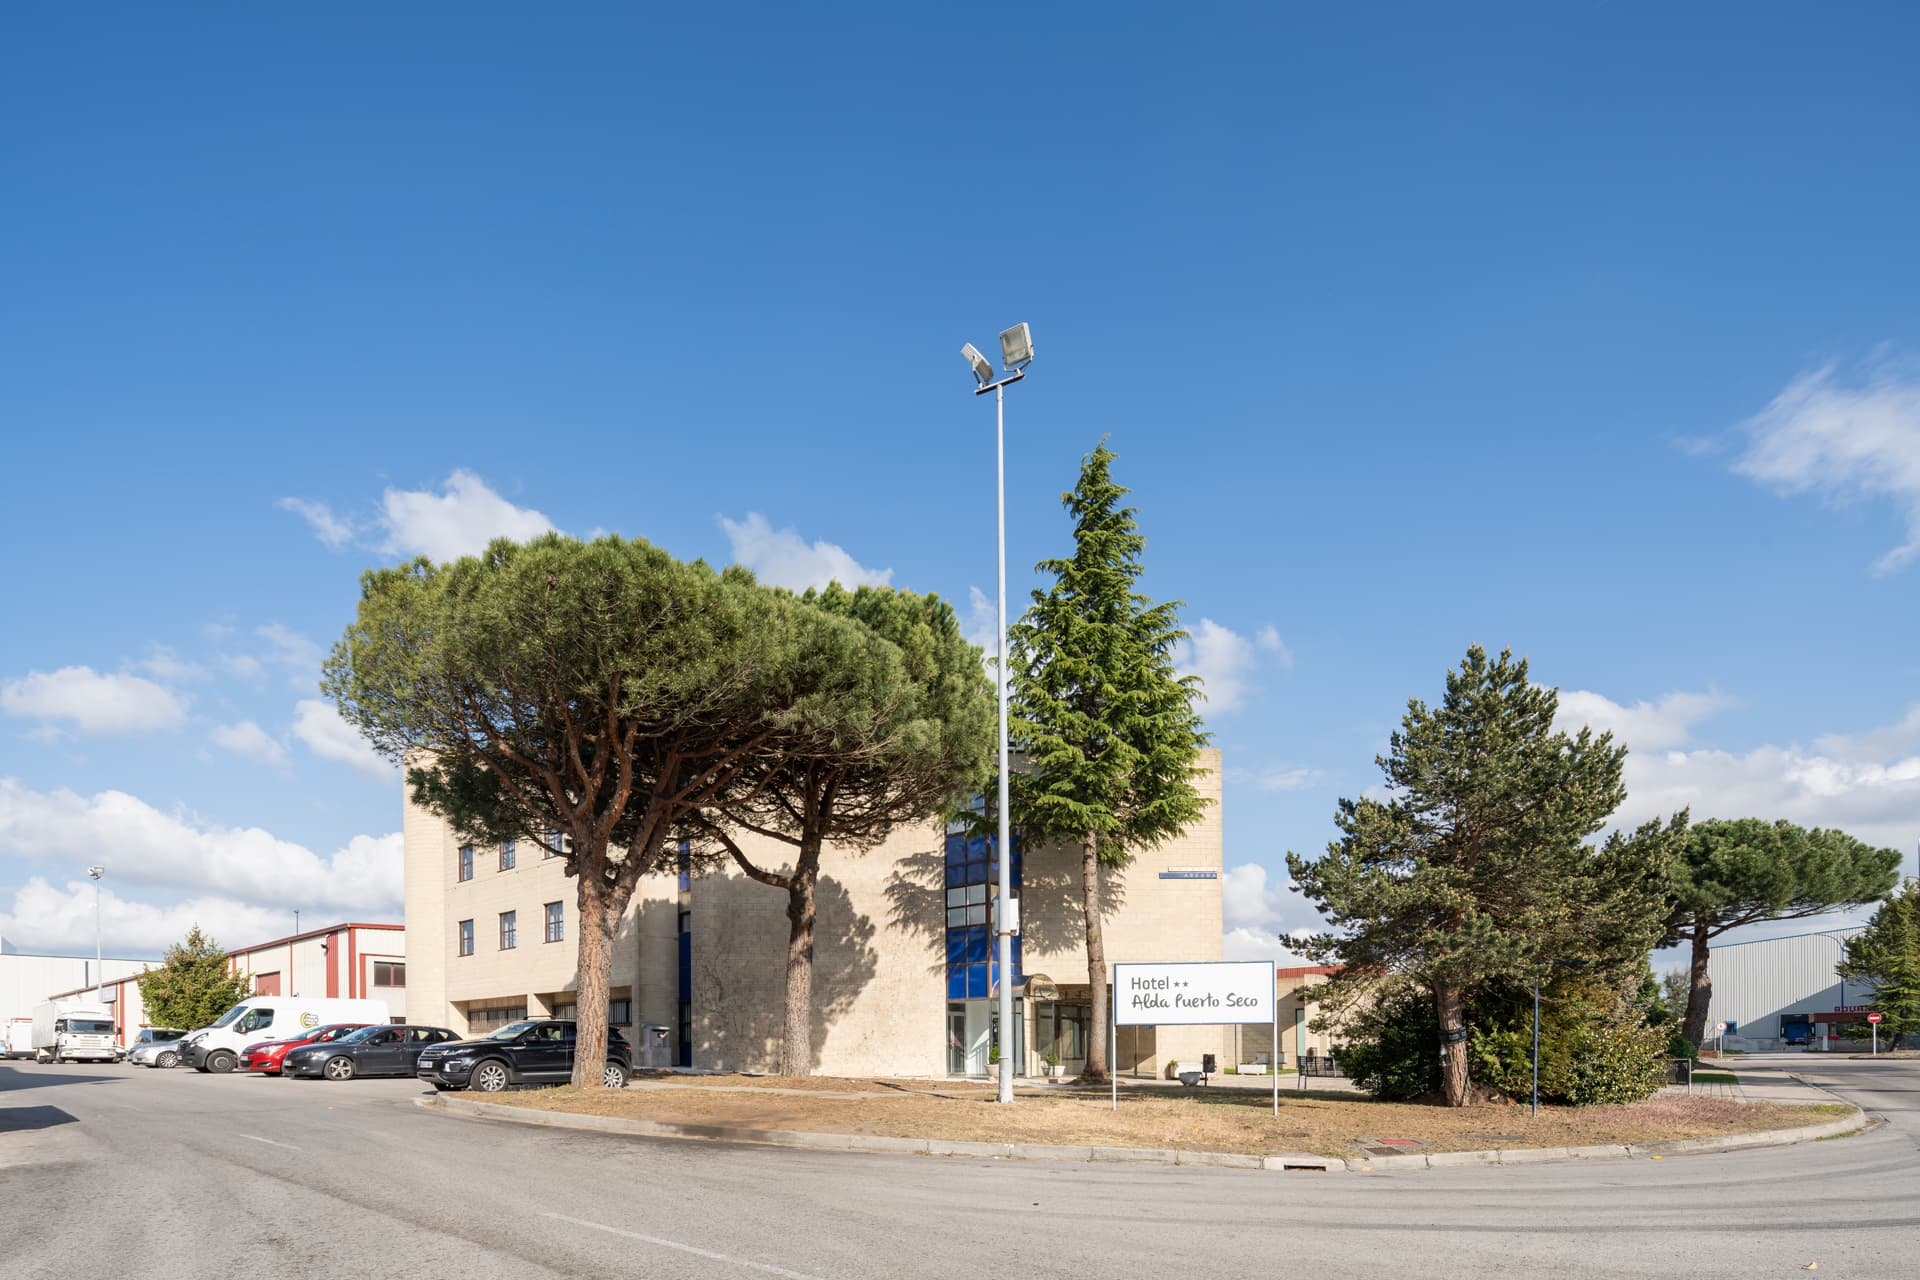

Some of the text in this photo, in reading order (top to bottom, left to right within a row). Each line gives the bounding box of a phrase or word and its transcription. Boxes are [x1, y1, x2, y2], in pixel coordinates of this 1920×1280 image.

[1131, 976, 1169, 990] Hotel
[1131, 992, 1258, 1011] Alda Puerto Seco
